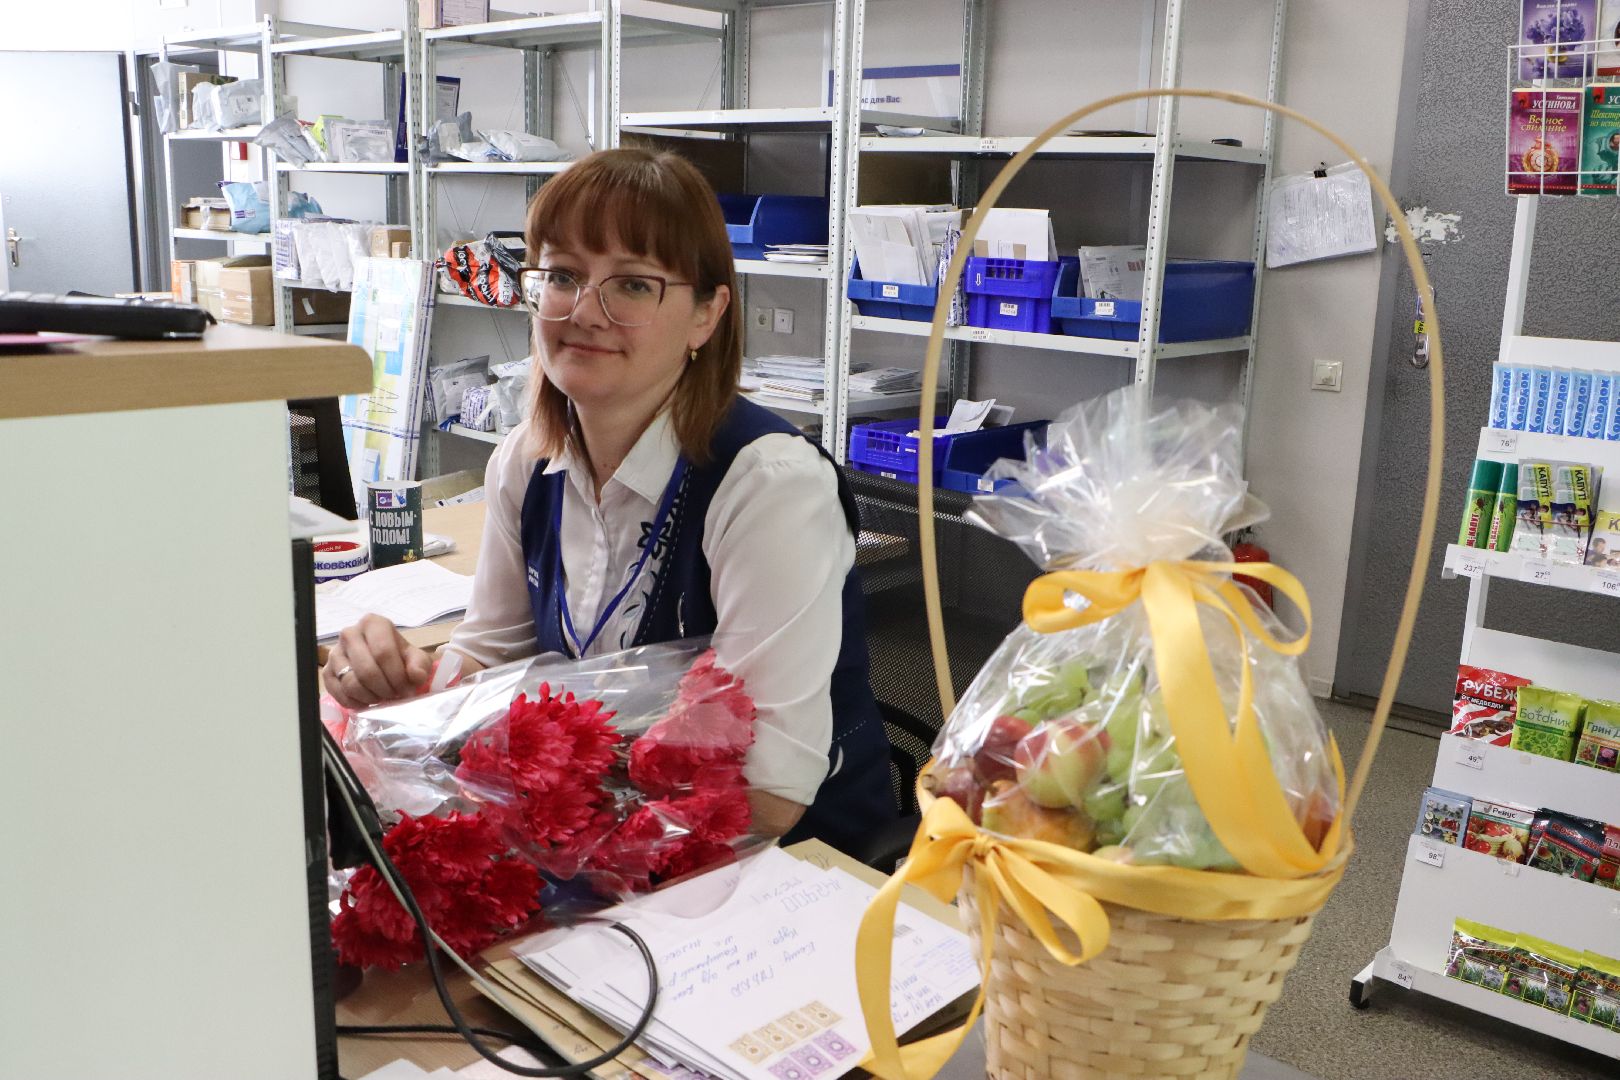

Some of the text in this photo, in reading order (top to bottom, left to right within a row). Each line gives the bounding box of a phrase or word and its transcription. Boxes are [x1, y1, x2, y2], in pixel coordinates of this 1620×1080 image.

[886, 95, 901, 103] Вас
[375, 511, 414, 527] НОВЫМ
[372, 527, 411, 545] ГОДОМ!
[1519, 706, 1571, 728] Ботаник
[1587, 721, 1611, 736] Грин
